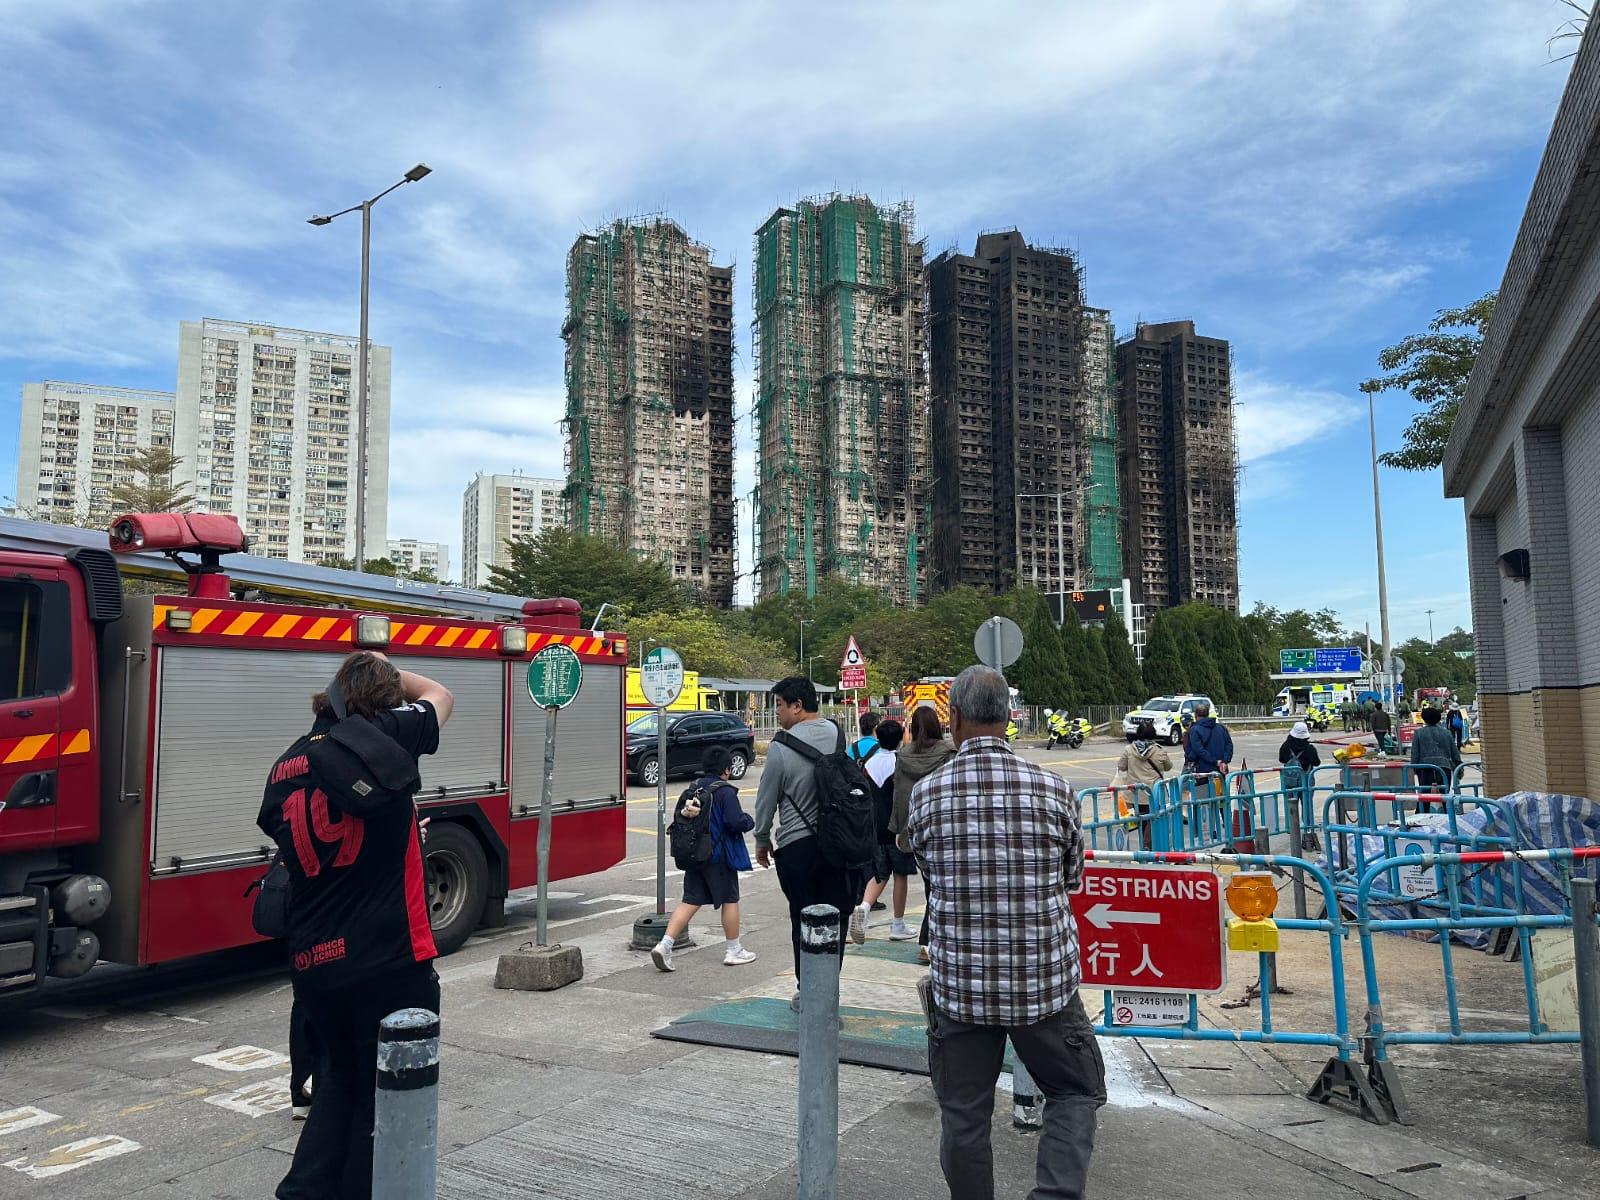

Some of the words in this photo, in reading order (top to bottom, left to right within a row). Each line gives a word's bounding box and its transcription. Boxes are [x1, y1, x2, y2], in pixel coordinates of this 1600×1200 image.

[282, 787, 364, 877] 19
[311, 937, 345, 954] UNHCR
[1087, 941, 1164, 978] 行人
[1116, 996, 1137, 1005] TEL:
